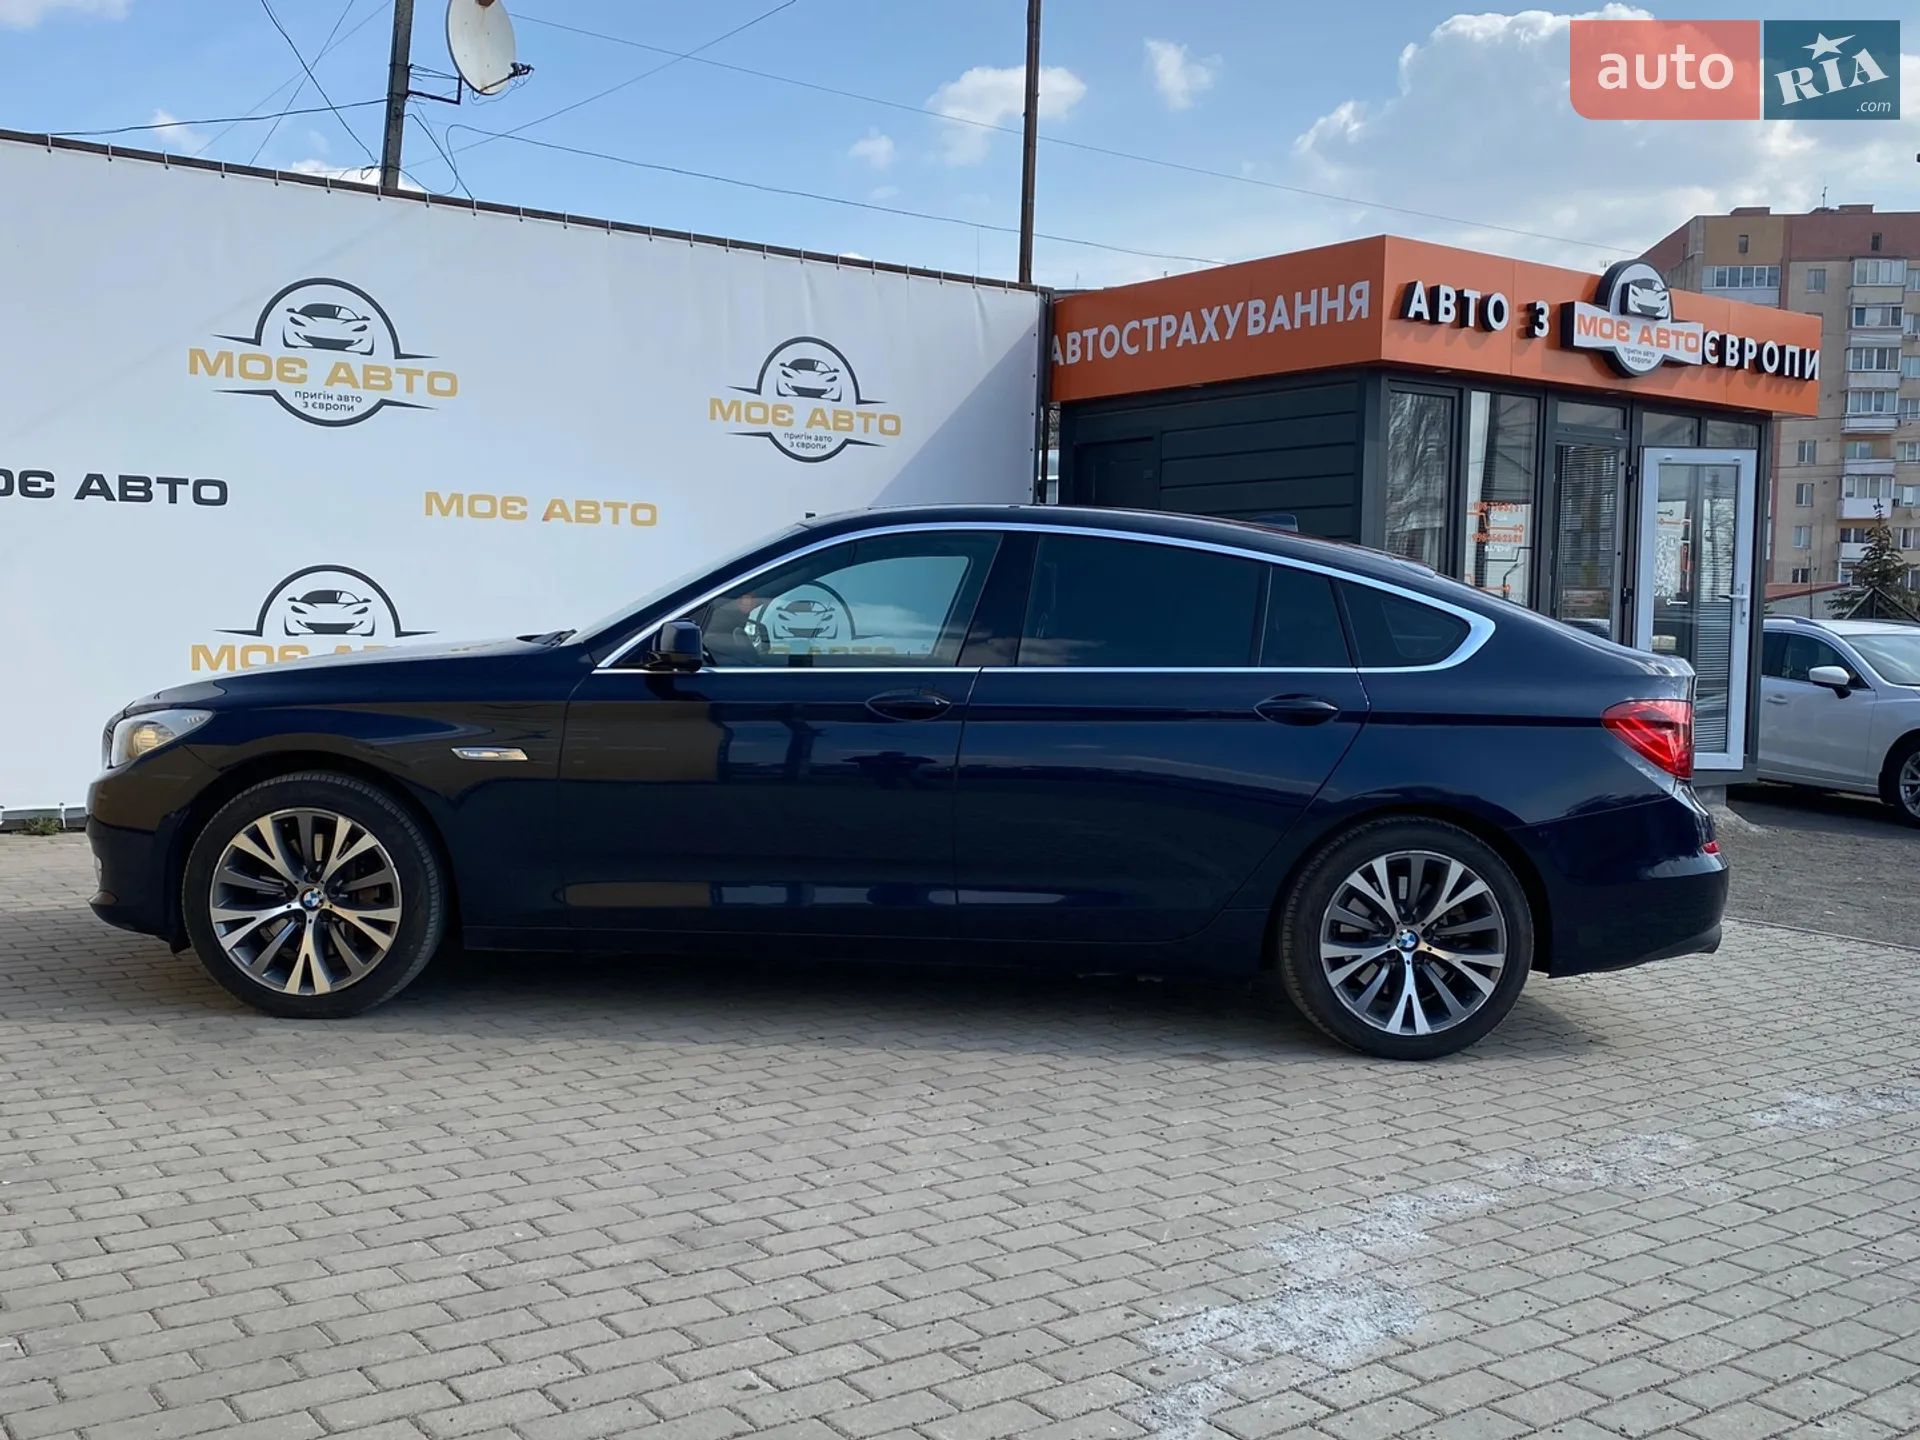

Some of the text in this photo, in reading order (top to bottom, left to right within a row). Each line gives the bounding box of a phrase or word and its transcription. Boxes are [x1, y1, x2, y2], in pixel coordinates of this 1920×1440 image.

[1051, 280, 1371, 367] АВТОСТРАХУВАННЯ
[1406, 280, 1820, 380] АВТО З ЄВРОПИ
[1577, 314, 1698, 352] МОЄ АВТО
[189, 348, 458, 397] МОЄ АВТО
[294, 390, 363, 404] пригін авто
[311, 402, 355, 412] європи
[709, 397, 902, 436] МОЄ АВТО
[814, 435, 833, 443] авто
[74, 473, 228, 506] АВТО
[425, 491, 658, 527] МОЄ АВТО
